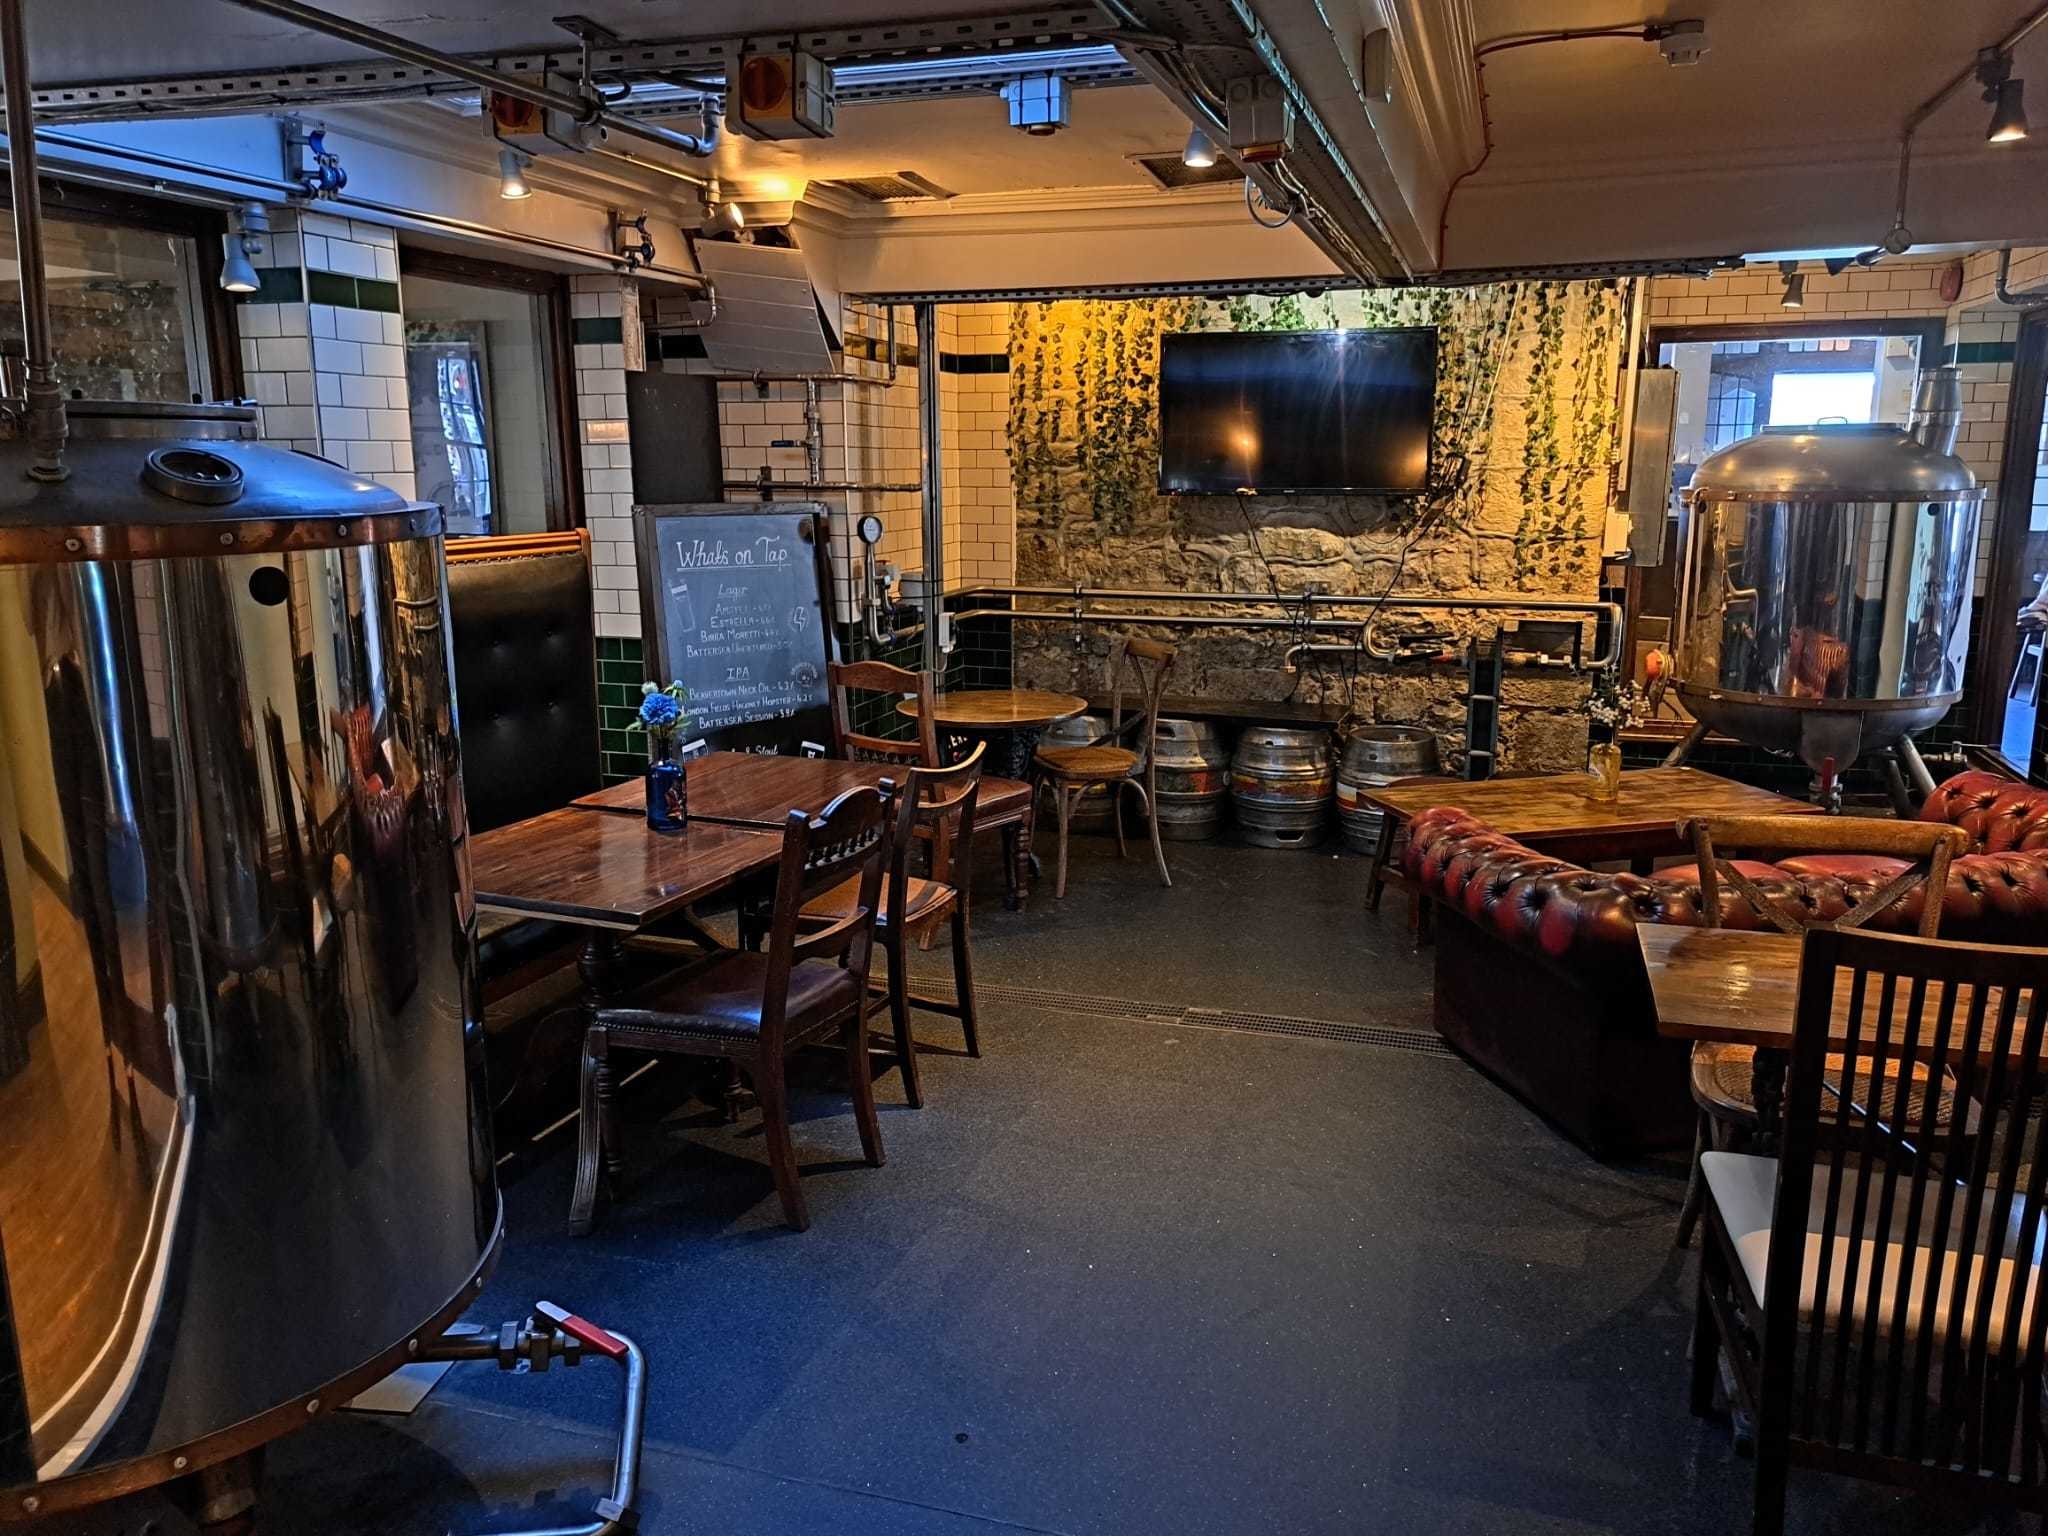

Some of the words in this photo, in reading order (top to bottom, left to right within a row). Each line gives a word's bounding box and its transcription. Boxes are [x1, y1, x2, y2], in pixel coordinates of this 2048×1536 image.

[735, 549, 754, 565] on
[755, 535, 788, 573] Tap
[727, 666, 750, 681] IPA
[699, 715, 742, 730] BATTERSEA
